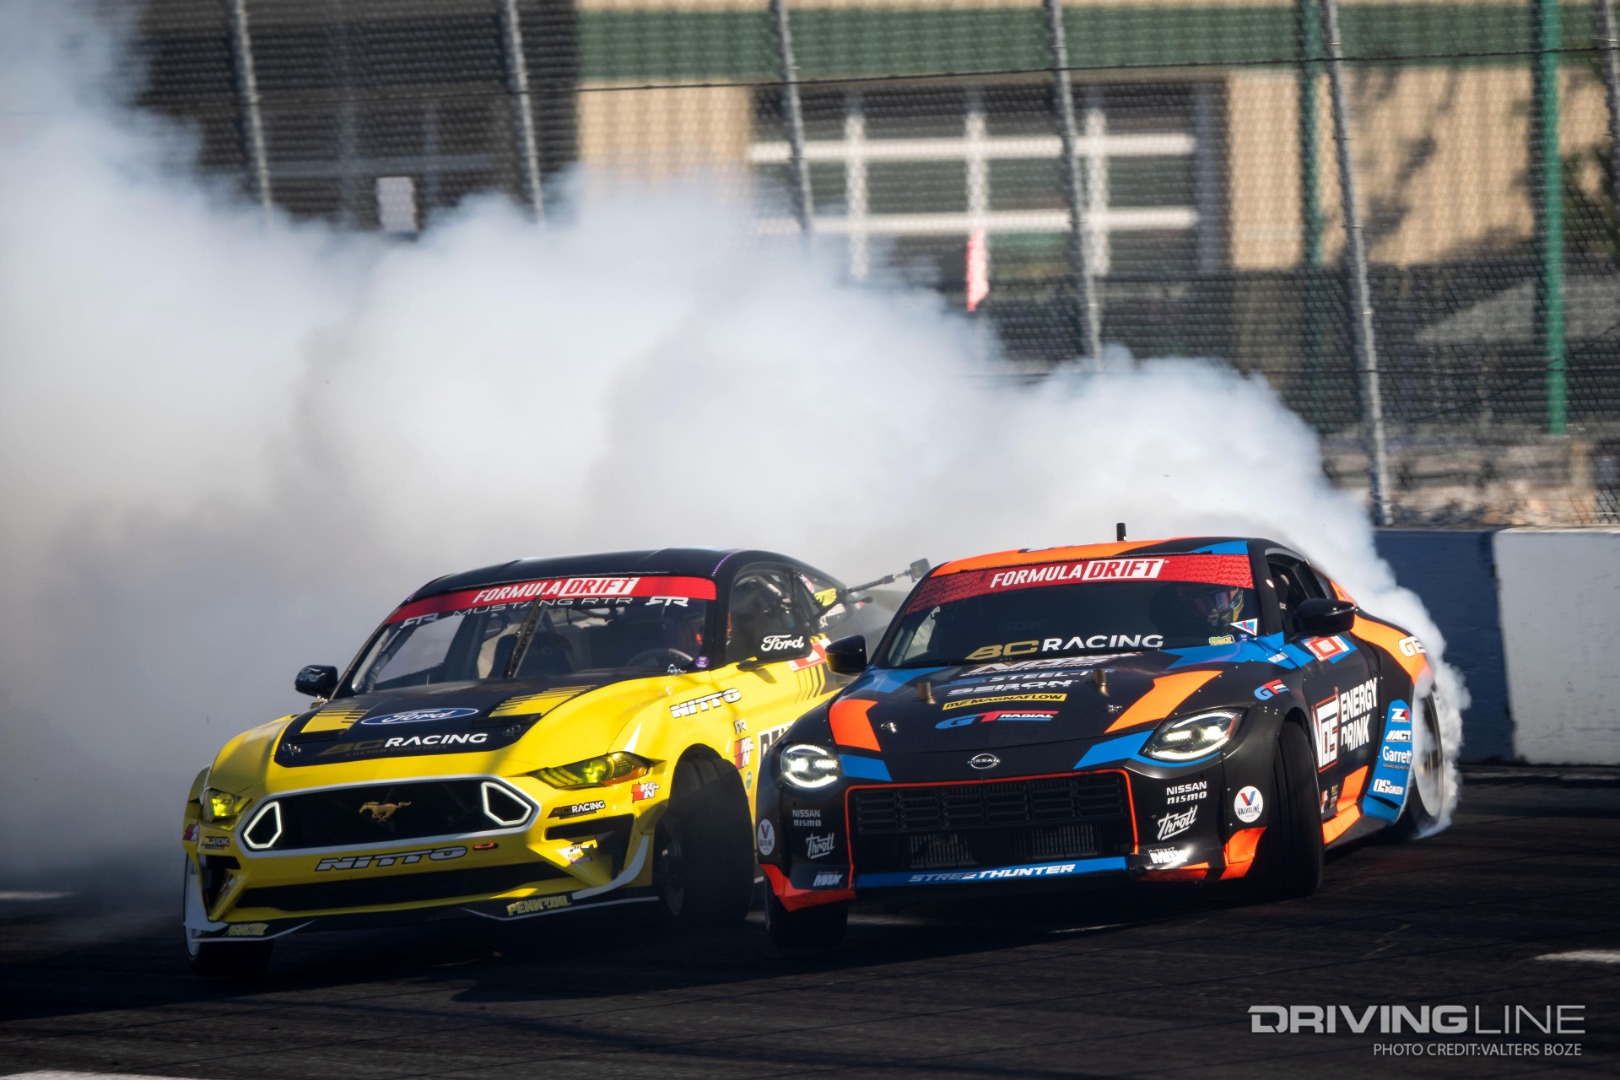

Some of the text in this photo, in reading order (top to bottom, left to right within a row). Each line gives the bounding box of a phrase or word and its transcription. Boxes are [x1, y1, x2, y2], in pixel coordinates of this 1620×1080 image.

[990, 560, 1159, 588] FORMULA DRIFT
[472, 578, 634, 603] FORMULA DRIFT
[581, 597, 634, 605] RTR
[760, 633, 804, 652] Ford
[964, 634, 1164, 660] BC RACING
[970, 694, 1063, 705] MAGNAFLOW
[1254, 678, 1284, 701] GT
[1340, 676, 1378, 723] ENERGY
[669, 687, 742, 719] NITTO
[381, 709, 457, 723] Ford
[935, 711, 1059, 729] GT
[385, 733, 488, 748] RACING
[1312, 696, 1339, 769] NOS
[1340, 713, 1371, 752] DRINK
[1166, 780, 1207, 796] NISSAN
[571, 800, 606, 814] RACING
[792, 809, 821, 818] NISSAN
[314, 845, 468, 872] NITTO
